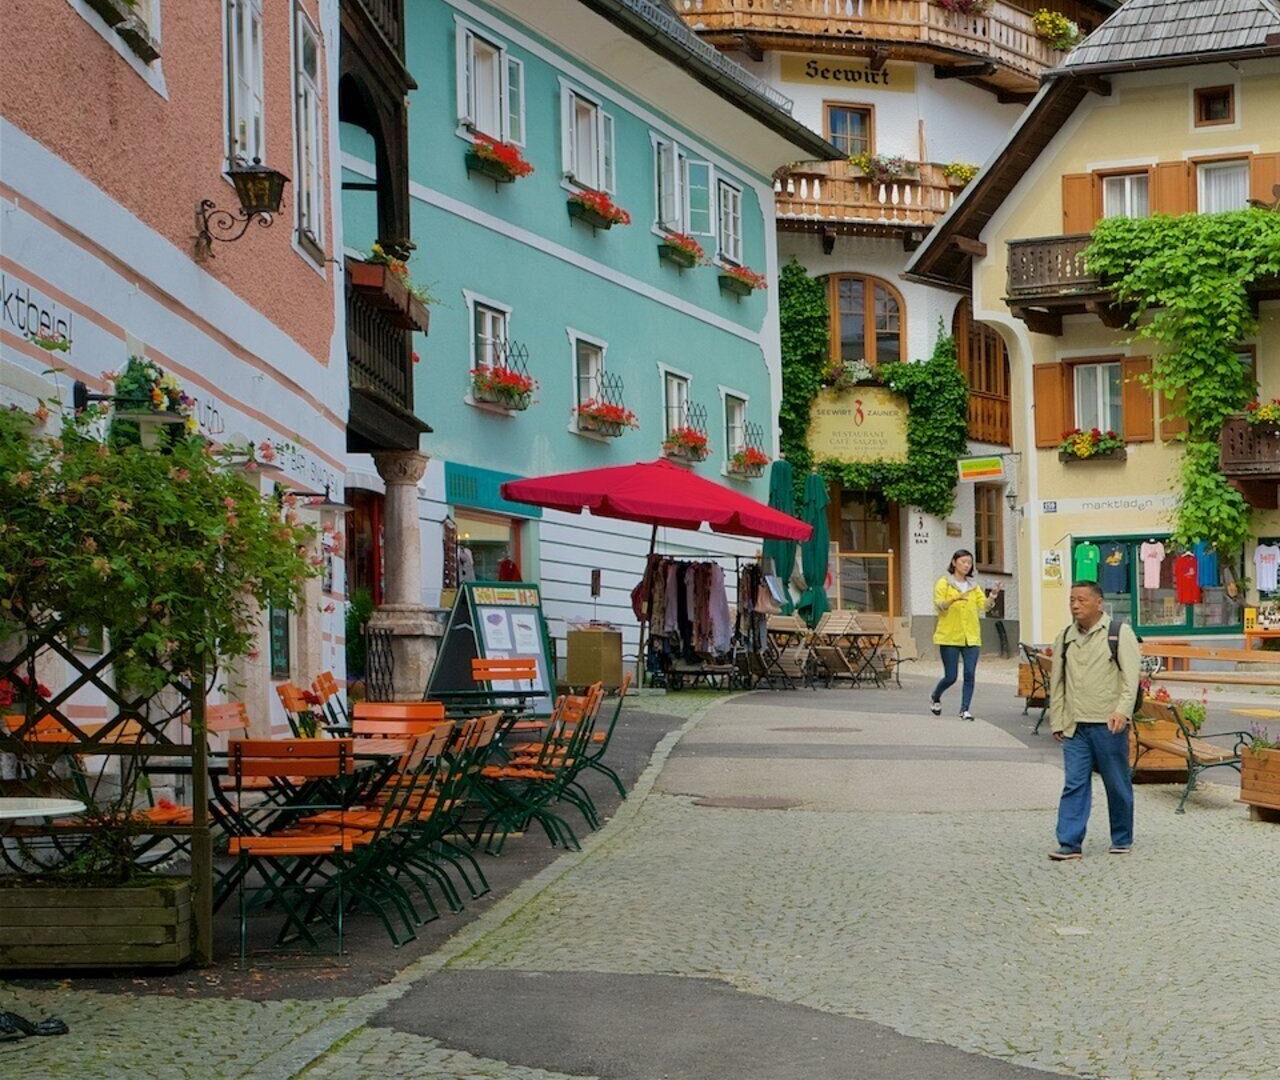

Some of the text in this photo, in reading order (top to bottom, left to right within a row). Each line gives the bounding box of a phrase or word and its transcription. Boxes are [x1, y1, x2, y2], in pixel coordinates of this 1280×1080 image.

[805, 60, 889, 85] Seewirt
[0, 274, 72, 355] ktbeisl
[867, 409, 900, 417] ZAUNER
[832, 431, 885, 439] RESTAURANT
[1082, 499, 1153, 512] marktladen
